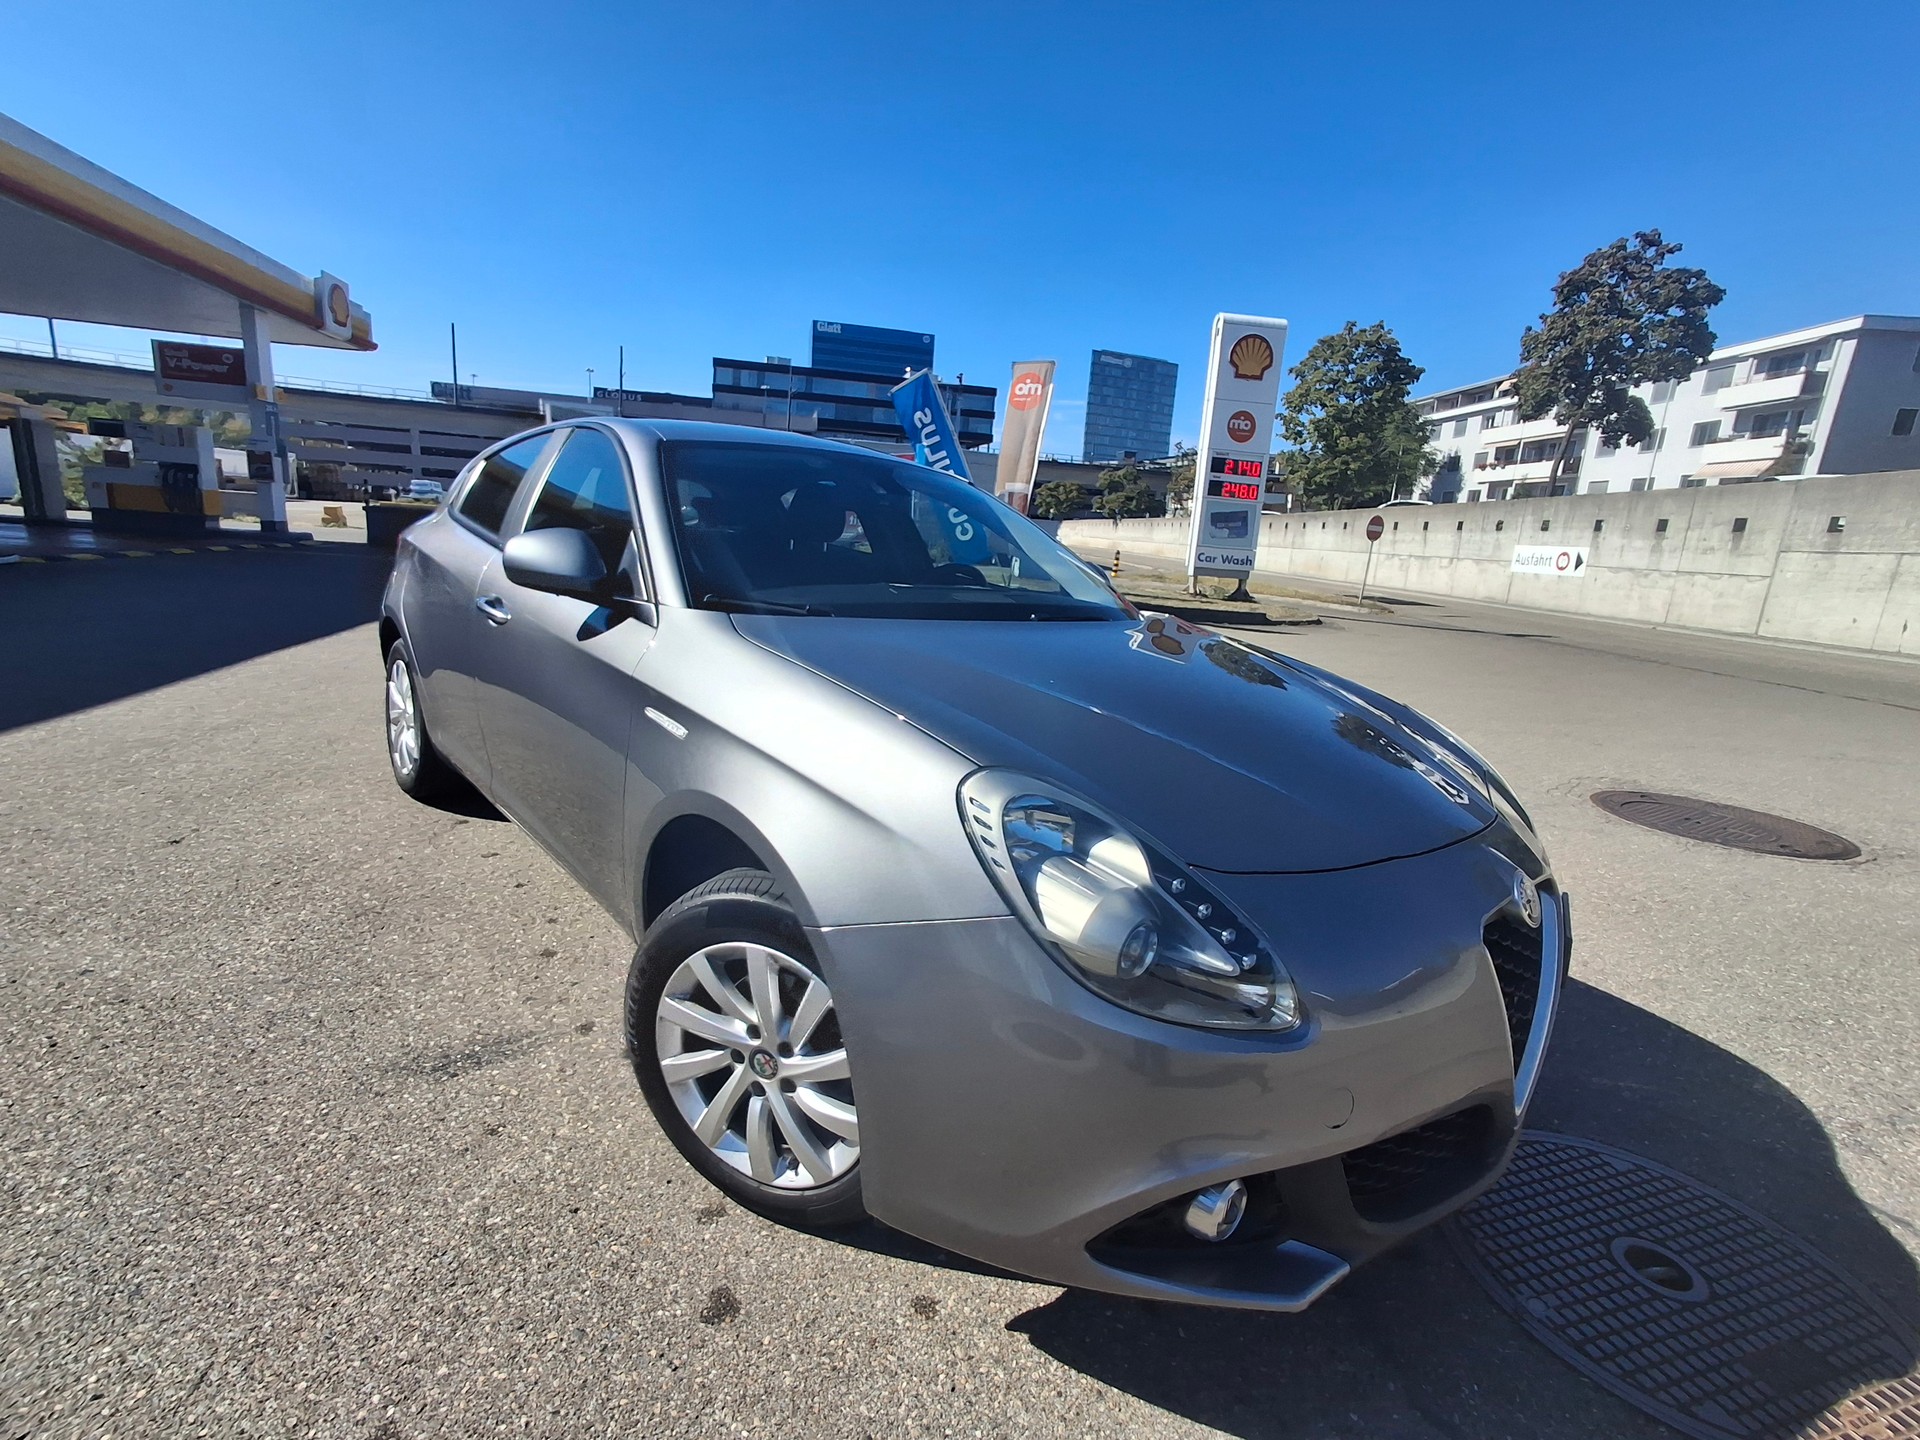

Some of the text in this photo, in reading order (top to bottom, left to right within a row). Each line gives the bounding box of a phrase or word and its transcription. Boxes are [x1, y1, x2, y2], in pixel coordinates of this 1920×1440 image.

[816, 321, 842, 334] Glatt
[1229, 415, 1252, 431] mio
[1197, 552, 1253, 566] Car Wash
[1515, 553, 1552, 567] Ausfahrt
